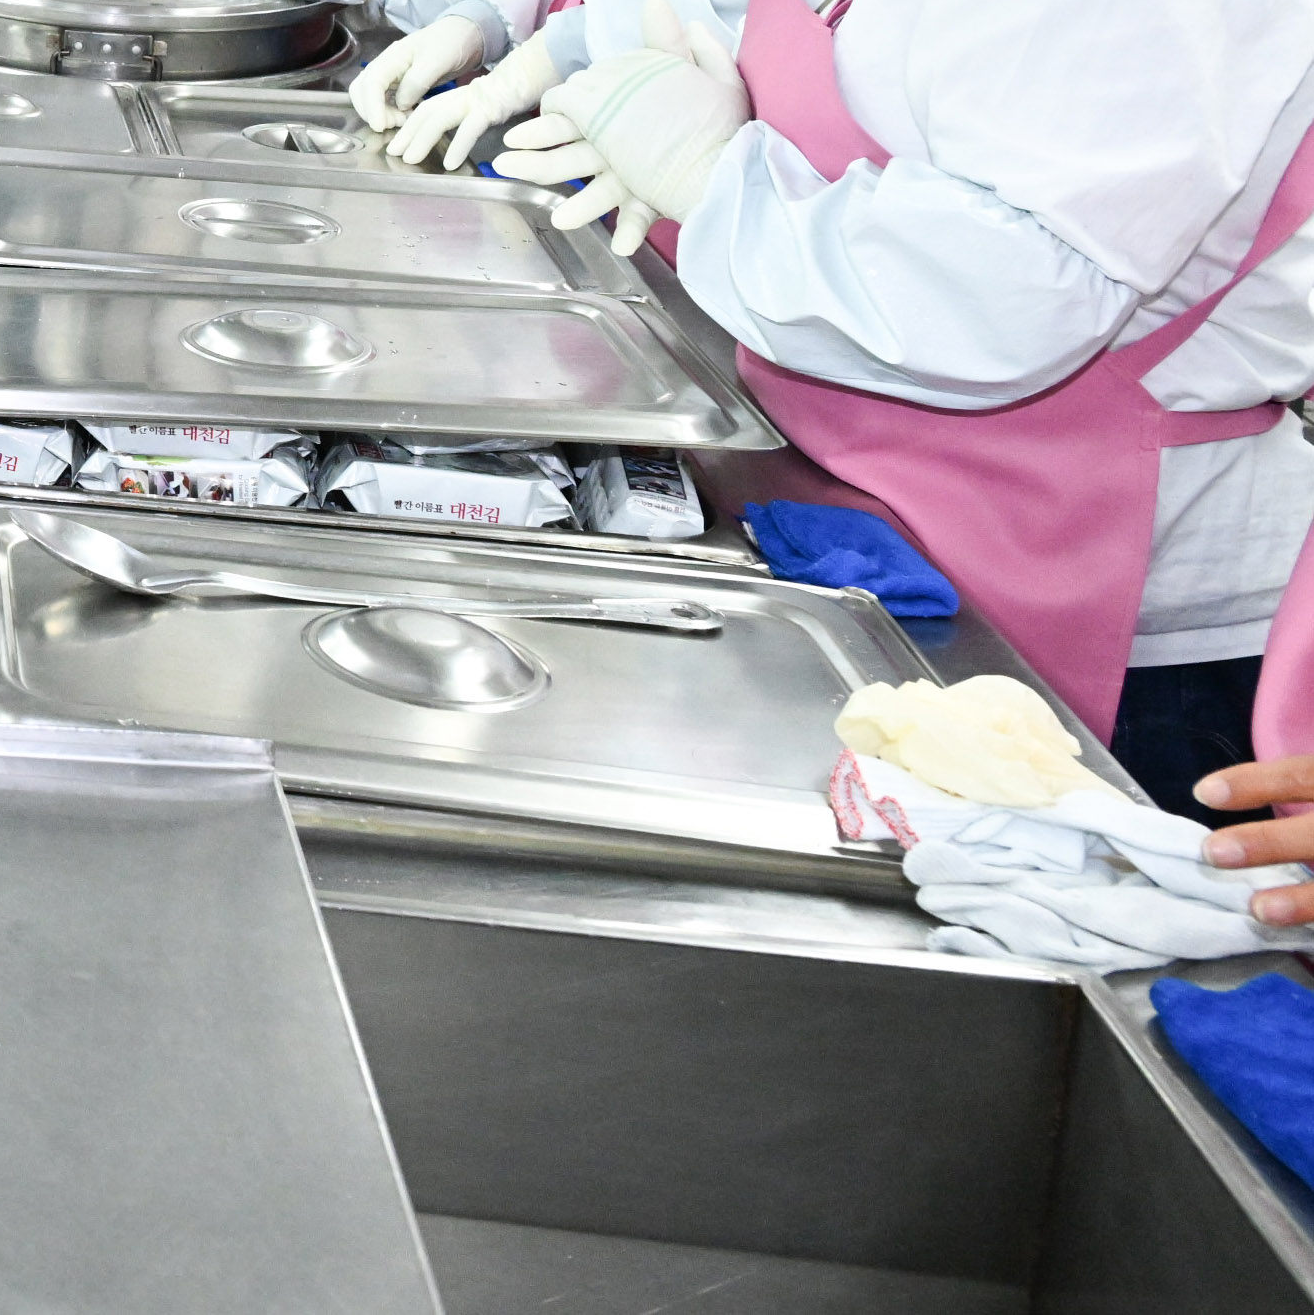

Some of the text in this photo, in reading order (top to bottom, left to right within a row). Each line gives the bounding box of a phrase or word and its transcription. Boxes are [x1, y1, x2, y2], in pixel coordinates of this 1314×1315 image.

[149, 426, 177, 436] 이름표
[182, 425, 231, 445] 대천김
[394, 499, 501, 524] 빨간 이름표 대천김
